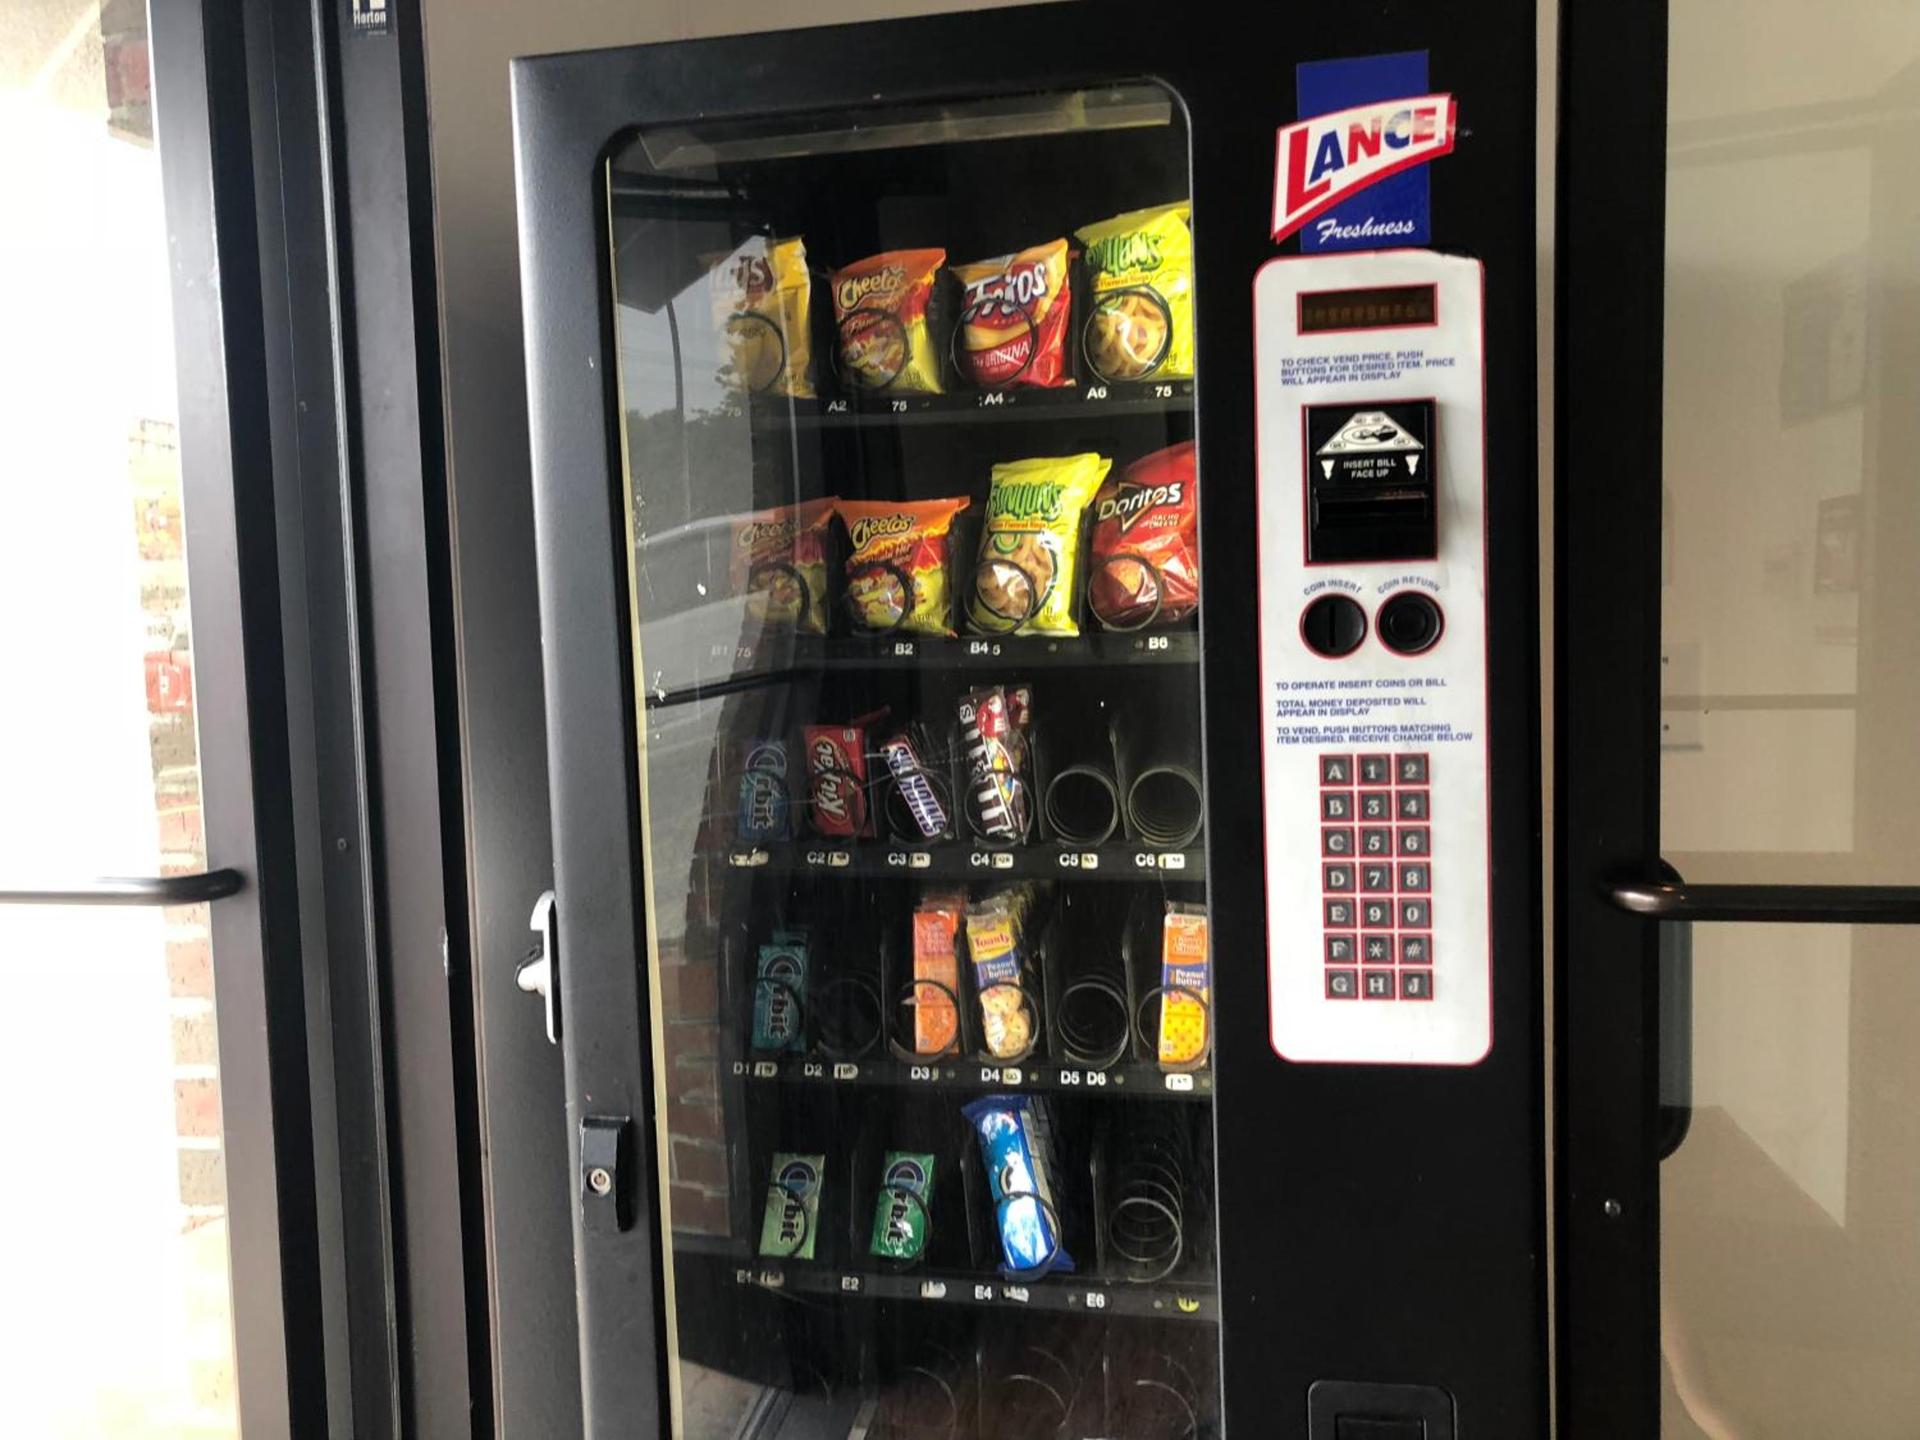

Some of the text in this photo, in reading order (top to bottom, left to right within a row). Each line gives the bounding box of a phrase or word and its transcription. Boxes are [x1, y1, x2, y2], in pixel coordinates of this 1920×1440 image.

[1286, 106, 1437, 218] LANCE
[1317, 216, 1415, 243] Freshness
[985, 341, 1031, 368] ORIGINA
[1281, 358, 1293, 367] TO
[1296, 356, 1329, 366] CHECK
[1333, 355, 1359, 364] VEND
[1396, 351, 1423, 360] PUSH
[1281, 366, 1327, 377] BUTTONS
[1329, 364, 1349, 374] FOR
[1352, 361, 1394, 372] DESIRED
[1426, 357, 1455, 367] PRICE
[1281, 371, 1402, 386] WILL APPEAR IN DISPLAY
[984, 392, 1004, 406] A4
[1087, 385, 1172, 400] A6 75
[828, 400, 847, 412] A2
[1343, 458, 1397, 469] INSERT BILL
[1351, 468, 1389, 478] FACE UP
[1098, 483, 1182, 521] Doritos
[738, 518, 797, 550] Chee
[852, 515, 914, 549] Cheetos
[1304, 579, 1362, 596] COIN INSERT
[1377, 576, 1441, 594] COIN RETURN
[895, 643, 913, 655] B2
[970, 641, 988, 654] B4
[1149, 637, 1168, 649] B6
[1276, 677, 1447, 691] TO OPERATE INSERT COINS OR BILL
[1276, 696, 1426, 709] TOTAL MONEY DEPOSITED WILL
[1276, 706, 1370, 718] APPEAR IN DISPLAY
[1277, 726, 1289, 735] TO
[1323, 725, 1350, 734] PUSH
[1352, 724, 1397, 734] BUTTONS
[1400, 723, 1451, 733] MATCHING
[1277, 734, 1299, 744] ITEM
[1349, 733, 1390, 743] RECEIVE
[1393, 732, 1434, 742] CHANGE
[1437, 731, 1473, 742] BELOW
[1327, 764, 1417, 780] A 1 2
[1328, 800, 1418, 816] B 3 4
[1328, 835, 1418, 851] C 5 6
[807, 852, 825, 864] C2
[888, 853, 906, 865] C3
[971, 853, 989, 866] C4
[1059, 853, 1078, 866] C5
[1135, 853, 1155, 866] C6
[1329, 871, 1419, 886] D 7 8
[1330, 906, 1345, 922] E
[1369, 906, 1381, 922] 9
[1332, 942, 1346, 957] F
[1175, 968, 1206, 980] Peanut
[1332, 977, 1420, 993] G H J
[733, 1062, 750, 1075] D1
[804, 1063, 822, 1076] D2
[911, 1067, 929, 1080] D3
[981, 1068, 1000, 1082] D4
[1061, 1071, 1106, 1086] D5 D6
[842, 1276, 859, 1290] E2
[975, 1285, 992, 1300] E4
[1086, 1293, 1105, 1308] E6
